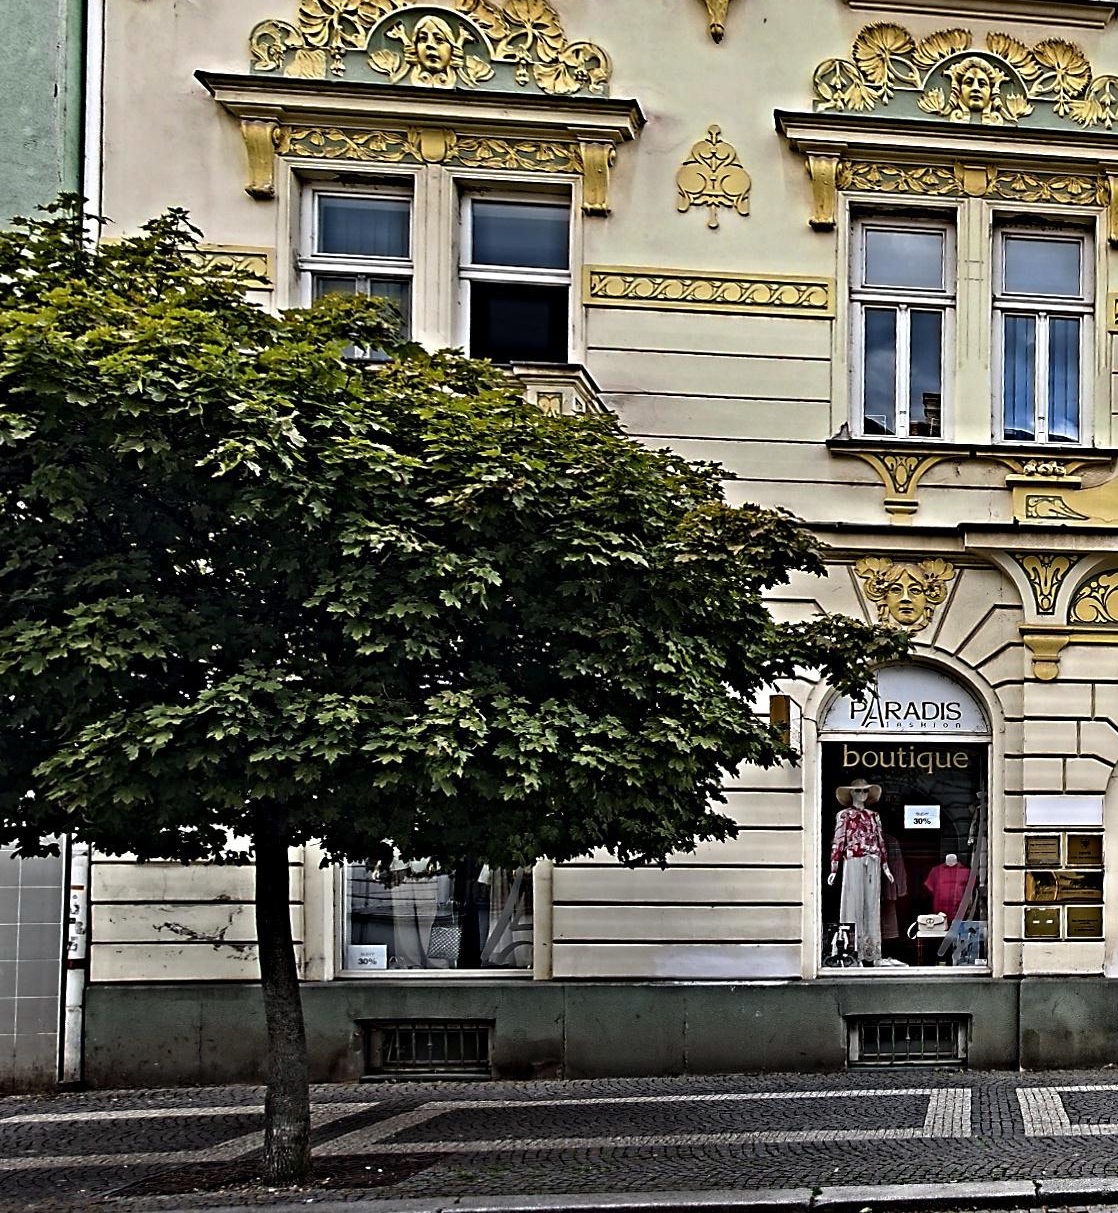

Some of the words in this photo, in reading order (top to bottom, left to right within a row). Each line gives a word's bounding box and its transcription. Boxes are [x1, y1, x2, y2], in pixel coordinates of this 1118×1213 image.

[850, 694, 962, 728] PARADIS
[843, 744, 968, 774] boutique
[358, 957, 377, 965] 30%
